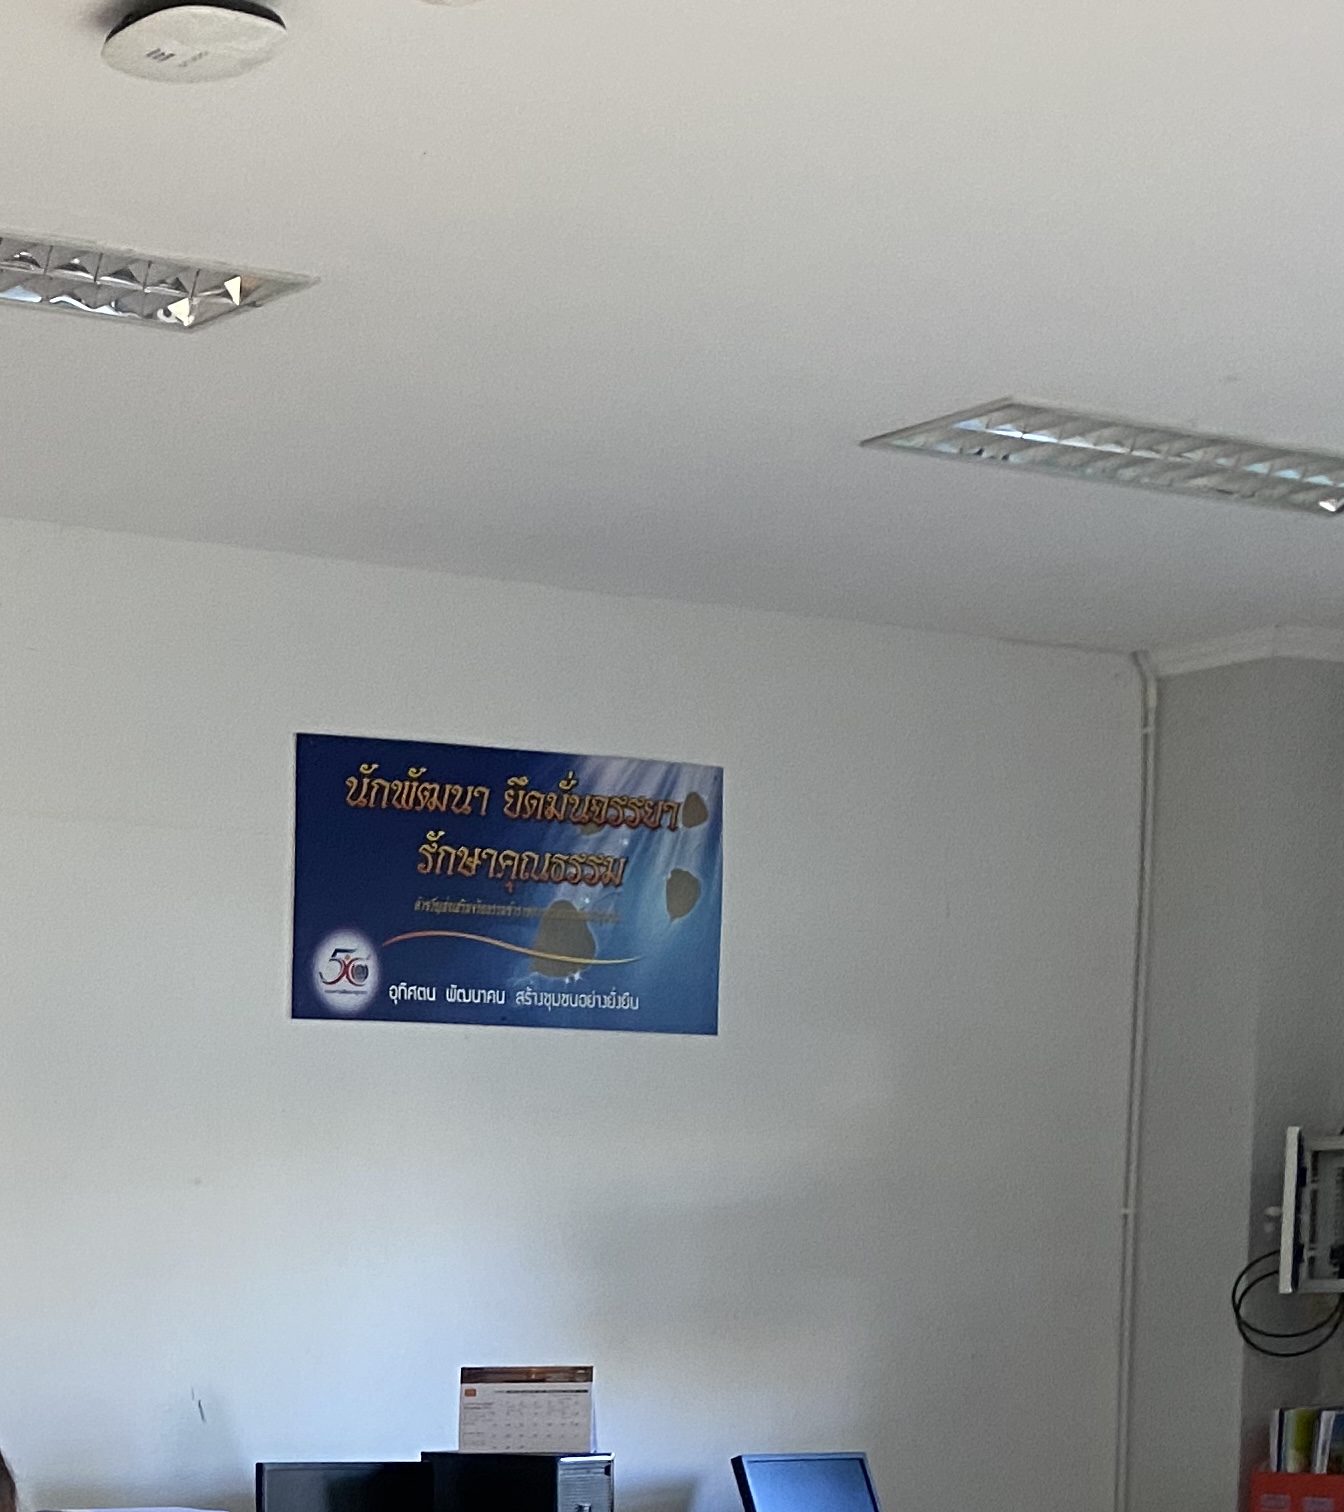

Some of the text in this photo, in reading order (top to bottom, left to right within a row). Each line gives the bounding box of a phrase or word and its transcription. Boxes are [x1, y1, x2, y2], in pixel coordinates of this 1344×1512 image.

[345, 763, 490, 816] นักพัฒนา
[415, 830, 628, 894] รักษาคุณธรรม
[445, 983, 506, 1005] พัฒนาคน
